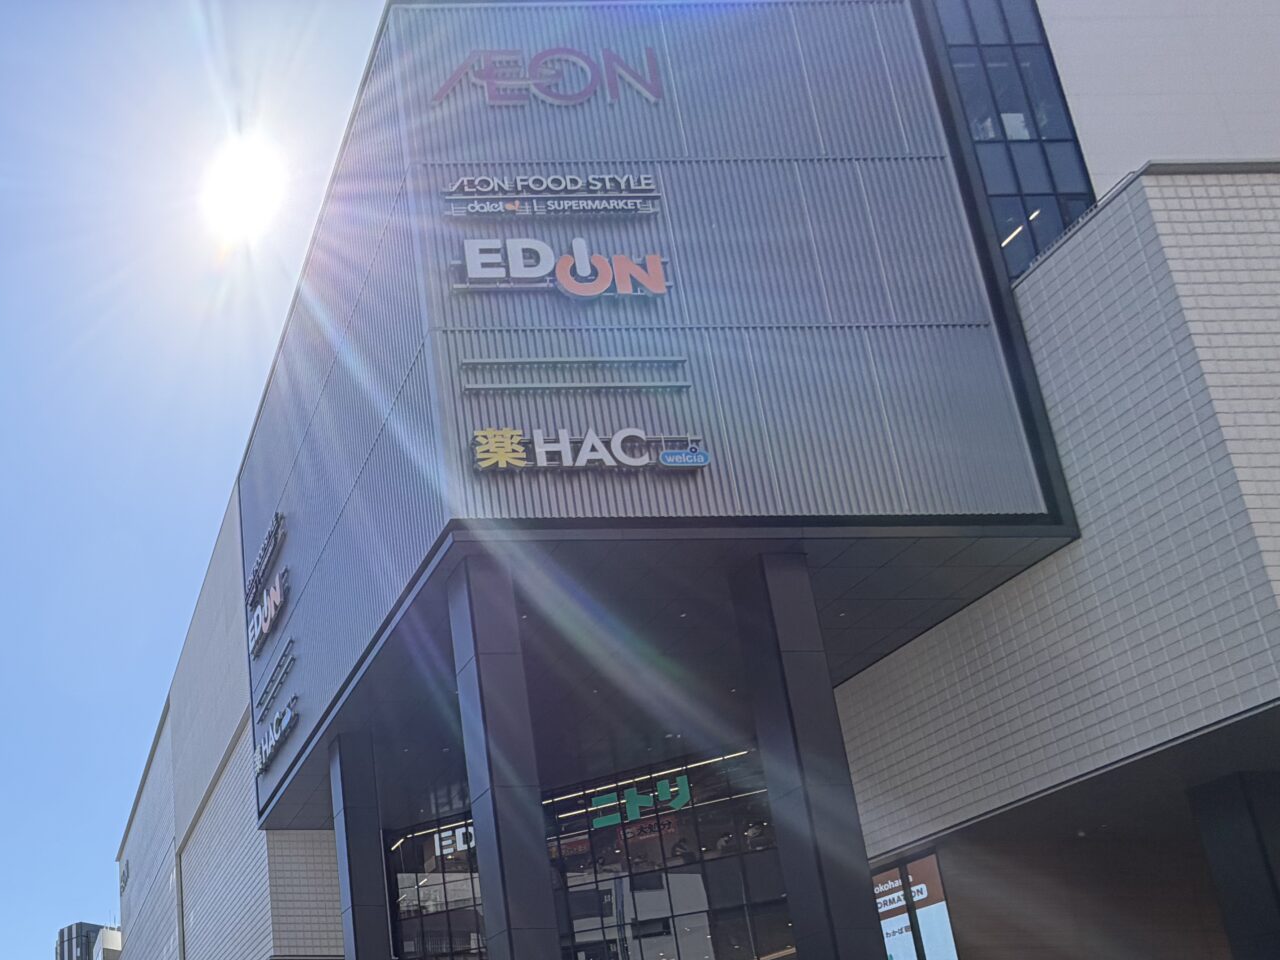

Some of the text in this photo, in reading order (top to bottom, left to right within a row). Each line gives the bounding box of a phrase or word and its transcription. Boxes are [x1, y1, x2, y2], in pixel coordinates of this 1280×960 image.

[516, 176, 582, 191] FOOD
[589, 175, 656, 190] STYLE
[547, 199, 643, 211] SUPERMARKET
[463, 237, 668, 296] EDION
[474, 427, 651, 468] 薬 HAC
[663, 452, 706, 465] welcia
[592, 775, 692, 829] ニトリ
